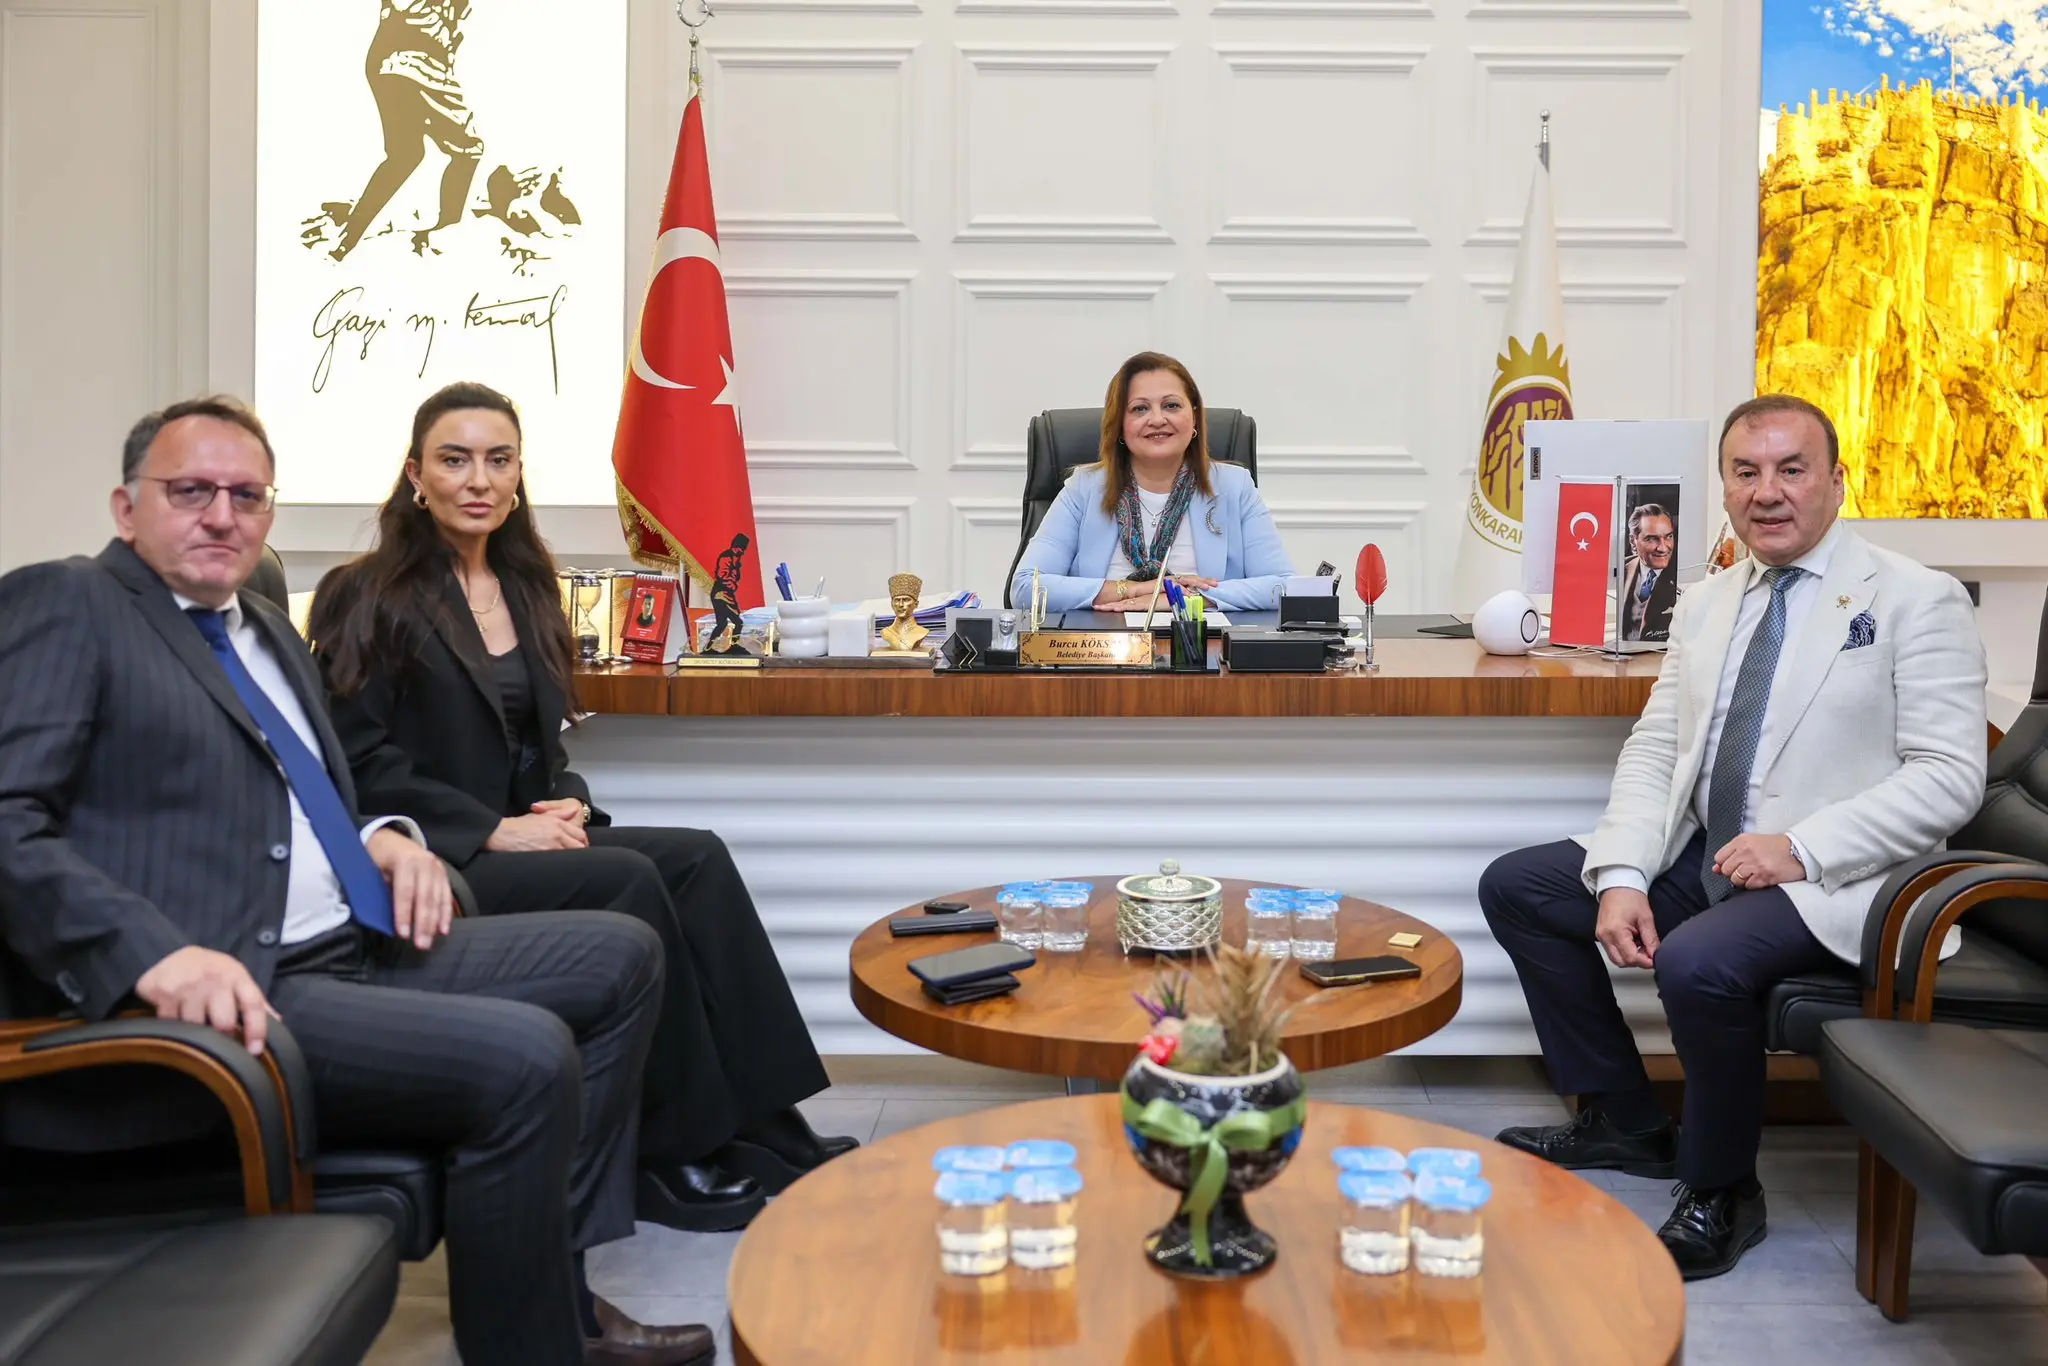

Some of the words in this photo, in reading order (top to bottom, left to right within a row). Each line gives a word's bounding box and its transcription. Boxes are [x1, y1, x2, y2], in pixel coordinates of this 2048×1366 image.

[1531, 449, 1539, 478] Lenovo
[1049, 639, 1078, 648] Burcu
[1056, 651, 1087, 659] Belediye
